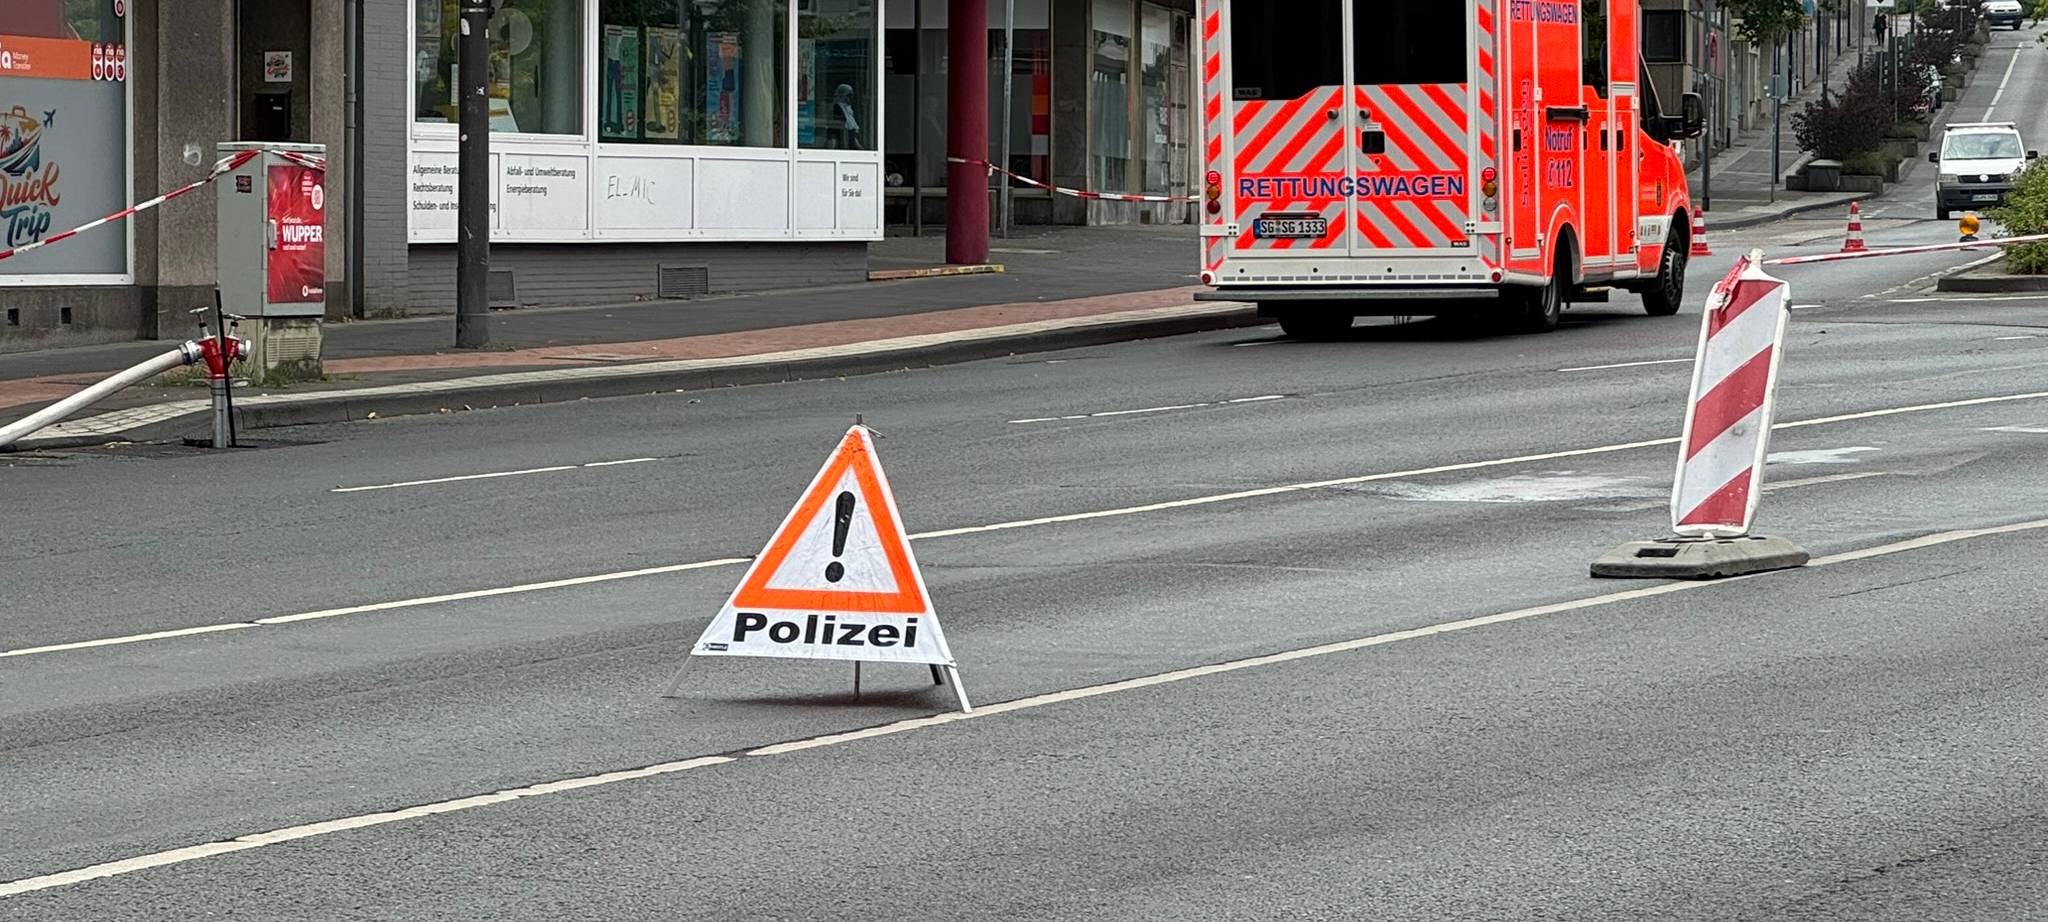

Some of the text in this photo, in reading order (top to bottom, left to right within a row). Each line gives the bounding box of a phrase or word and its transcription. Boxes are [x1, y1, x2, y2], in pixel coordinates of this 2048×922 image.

[1510, 0, 1578, 24] RETTUNGSWAGEN
[1545, 125, 1573, 151] Notruf
[412, 165, 442, 176] Allgemeine
[506, 167, 576, 179] Abfall- und Umweltberatung
[413, 183, 453, 194] Rechtsberatung
[506, 184, 548, 196] Energieberatung
[1239, 175, 1464, 198] RETTUNGSWAGEN
[412, 200, 438, 210] Schulden-
[439, 200, 449, 210] und
[0, 203, 51, 248] Trip
[1261, 220, 1325, 233] SG SG 1333
[282, 225, 323, 243] WUPPER
[732, 612, 919, 648] Polizei
